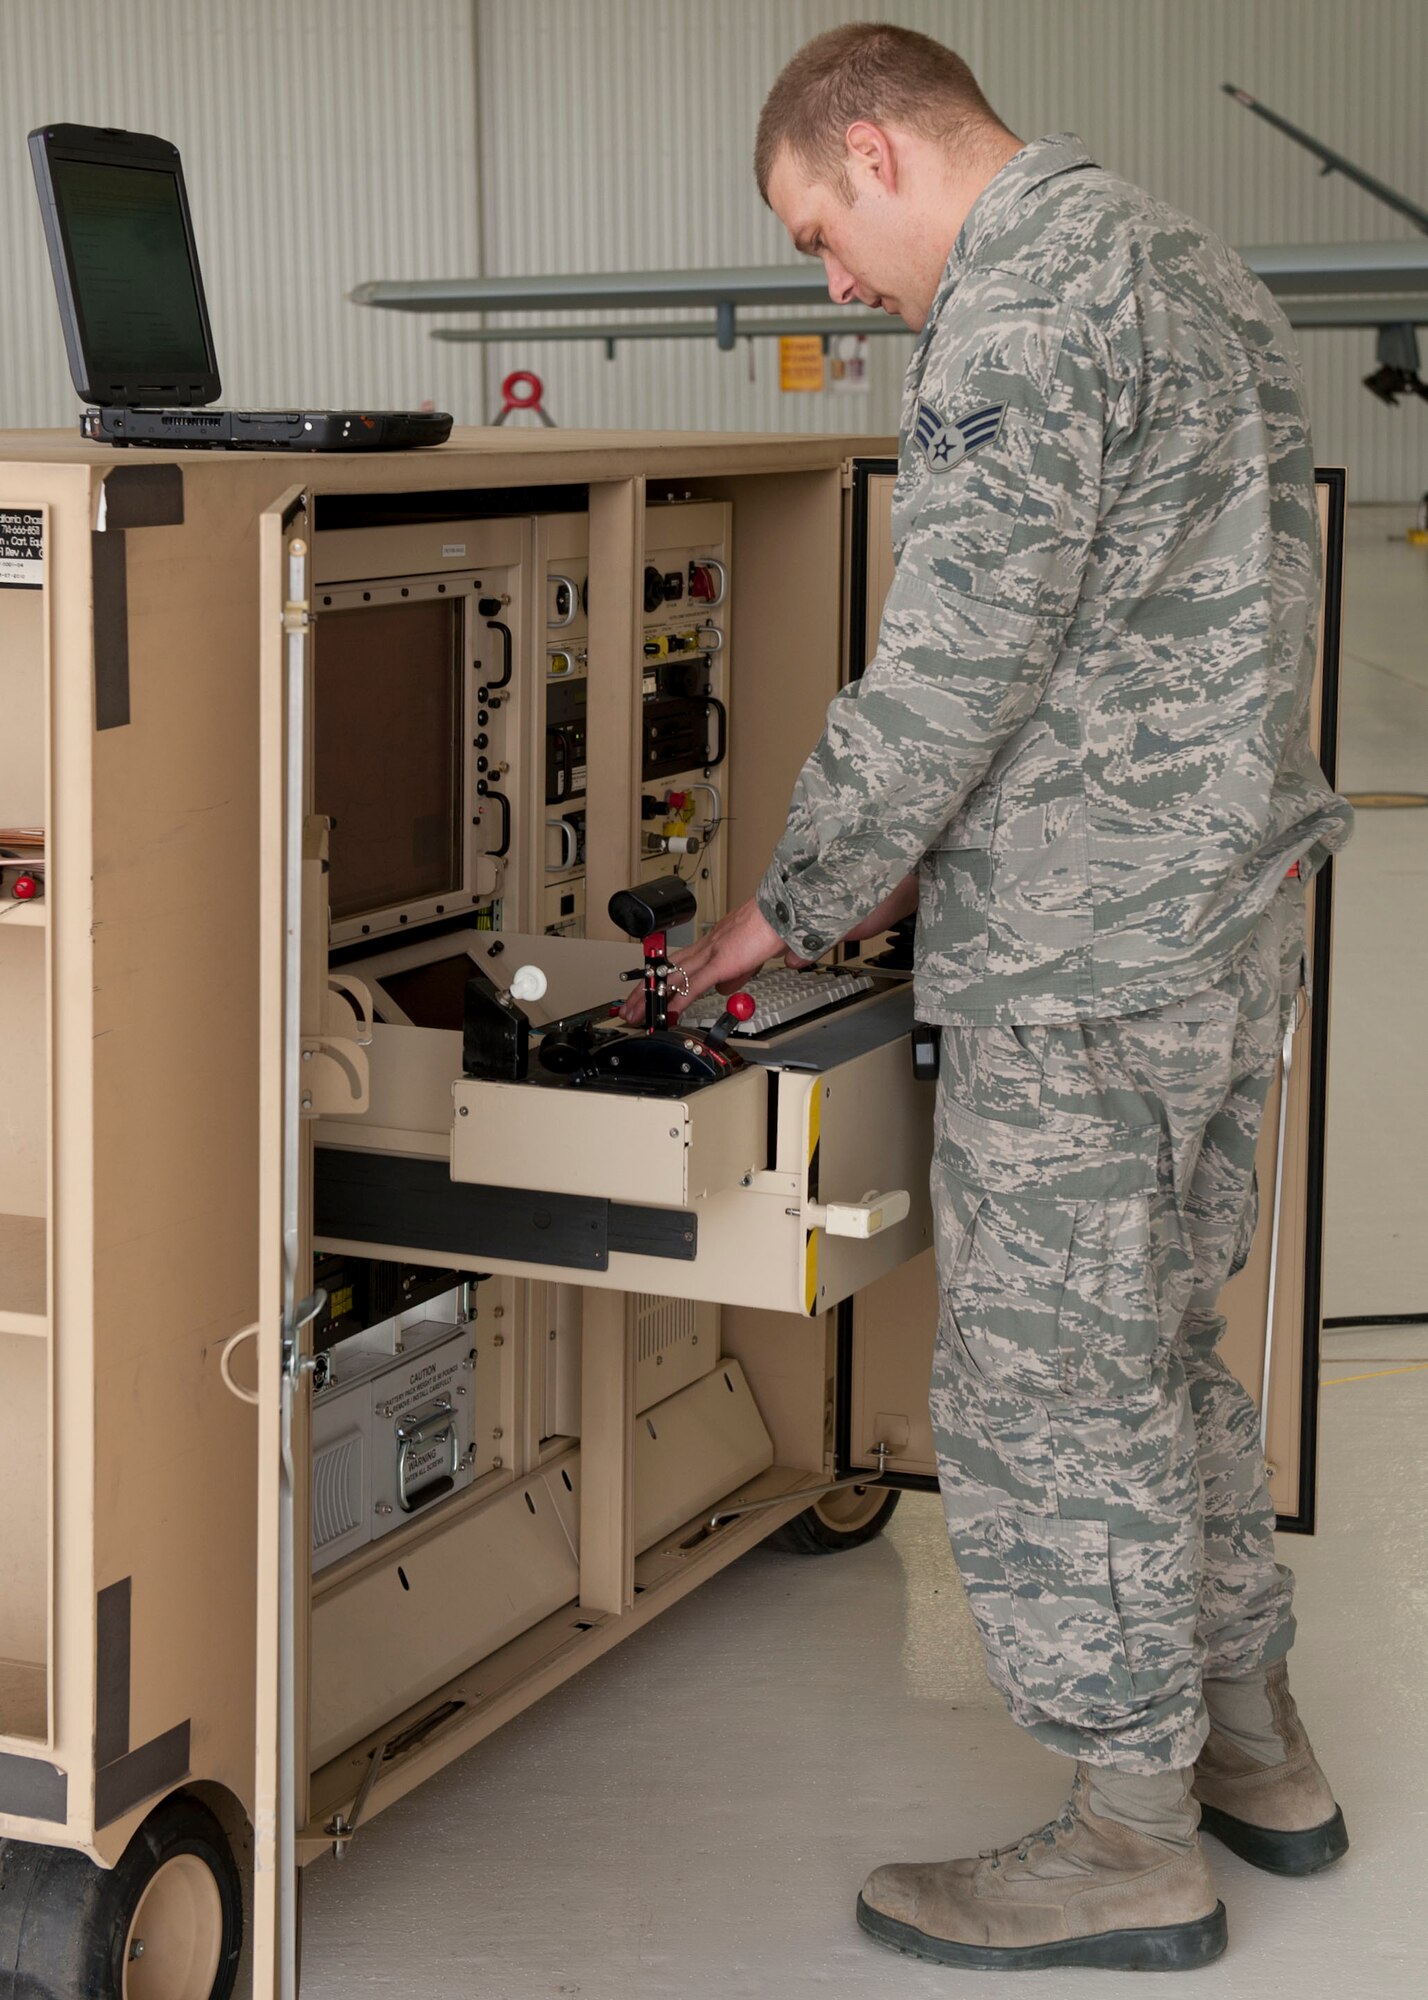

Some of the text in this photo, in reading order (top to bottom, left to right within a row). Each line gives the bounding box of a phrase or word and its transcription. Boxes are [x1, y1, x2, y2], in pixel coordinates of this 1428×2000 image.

[409, 1362, 437, 1385] CAUTION
[416, 1377, 432, 1391] WEIGHT
[442, 1363, 458, 1378] POUNDS
[413, 1390, 429, 1402] INSTALL
[429, 1376, 453, 1394] CAREFULLY
[408, 1448, 437, 1472] WARNING
